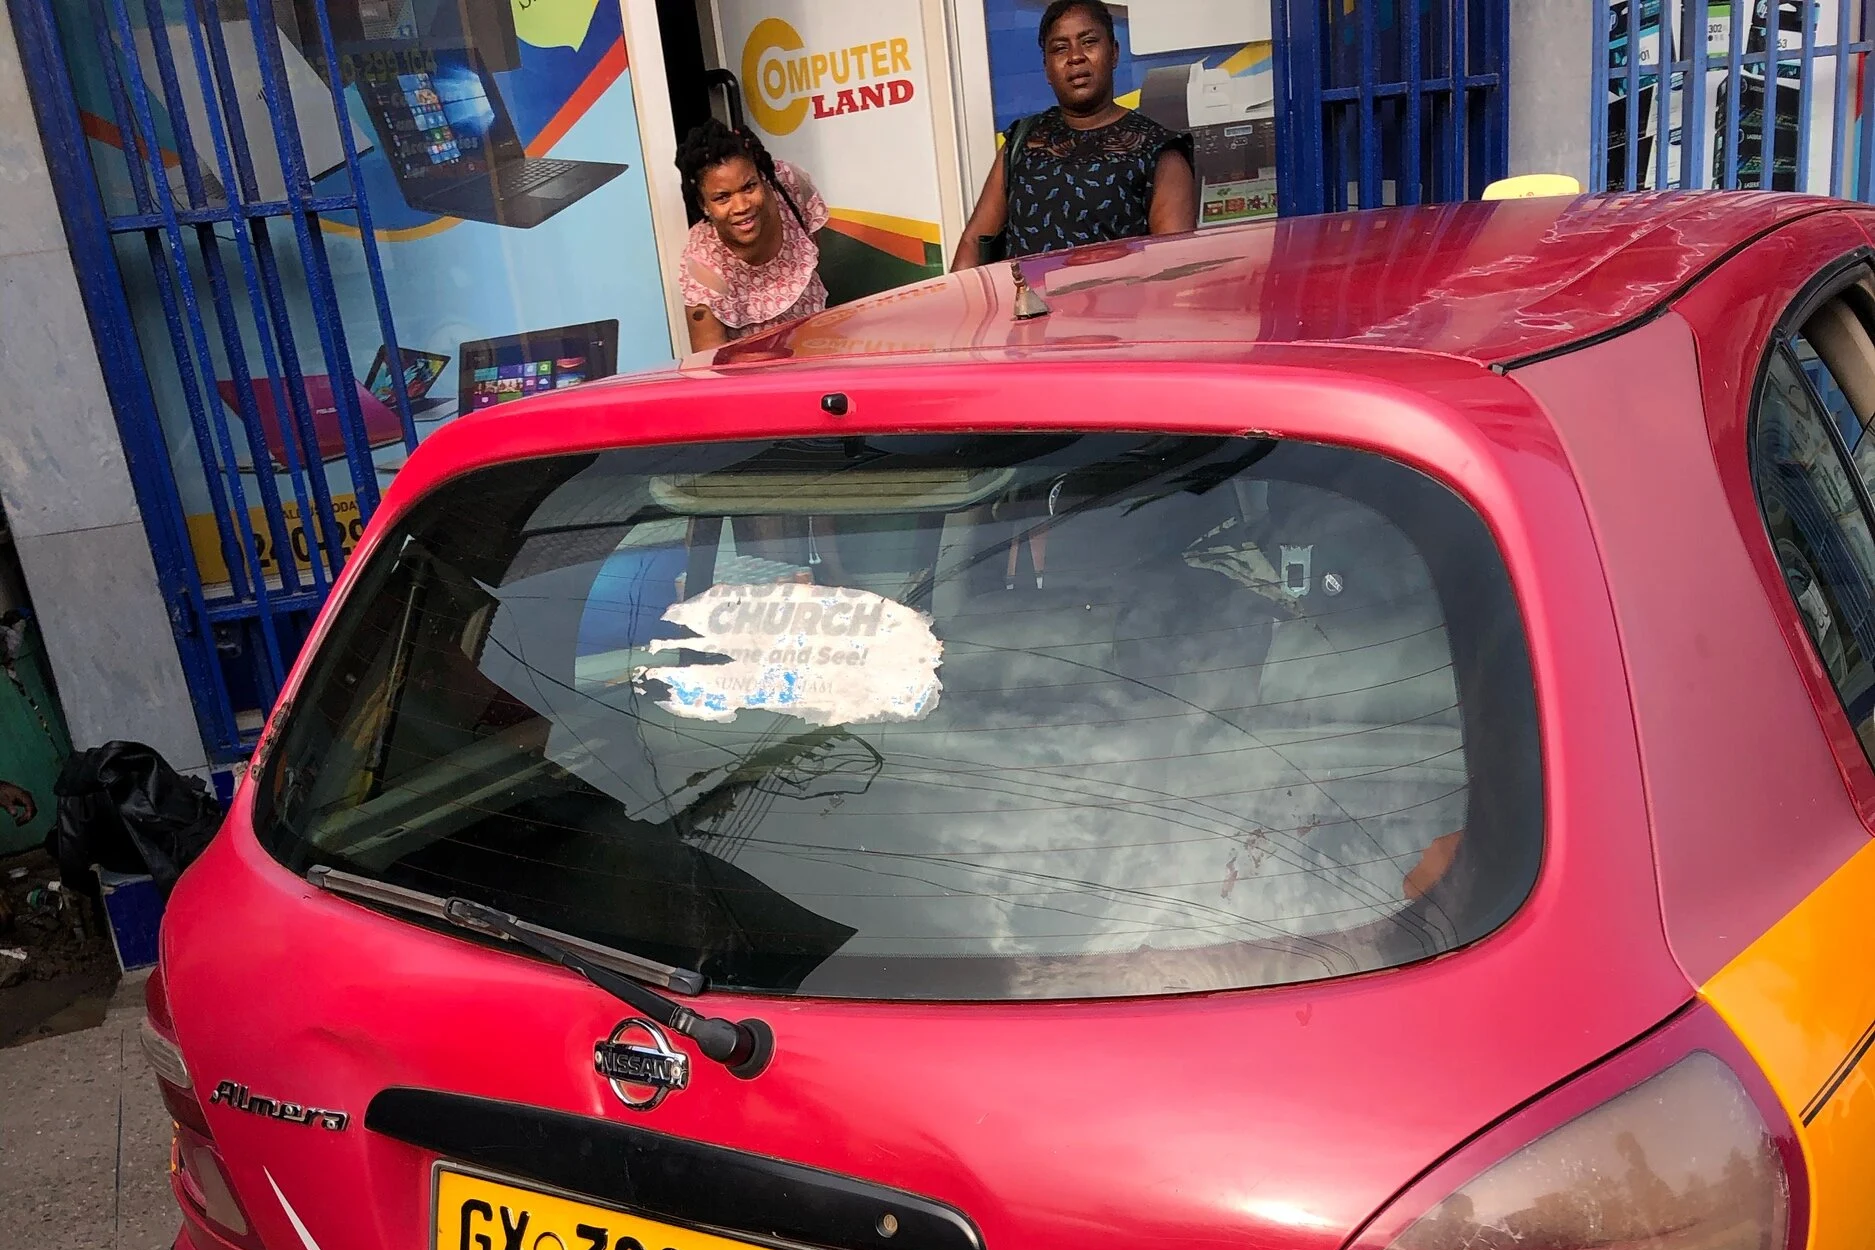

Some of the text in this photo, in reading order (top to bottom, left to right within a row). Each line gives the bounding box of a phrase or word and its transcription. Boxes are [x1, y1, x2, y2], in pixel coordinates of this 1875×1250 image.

[742, 17, 912, 136] COMPUTER
[812, 79, 914, 119] LAND
[708, 601, 885, 636] CHURCH
[768, 646, 813, 664] and
[816, 646, 870, 666] See!
[601, 1051, 672, 1080] NISSAN
[209, 1080, 350, 1132] Almera
